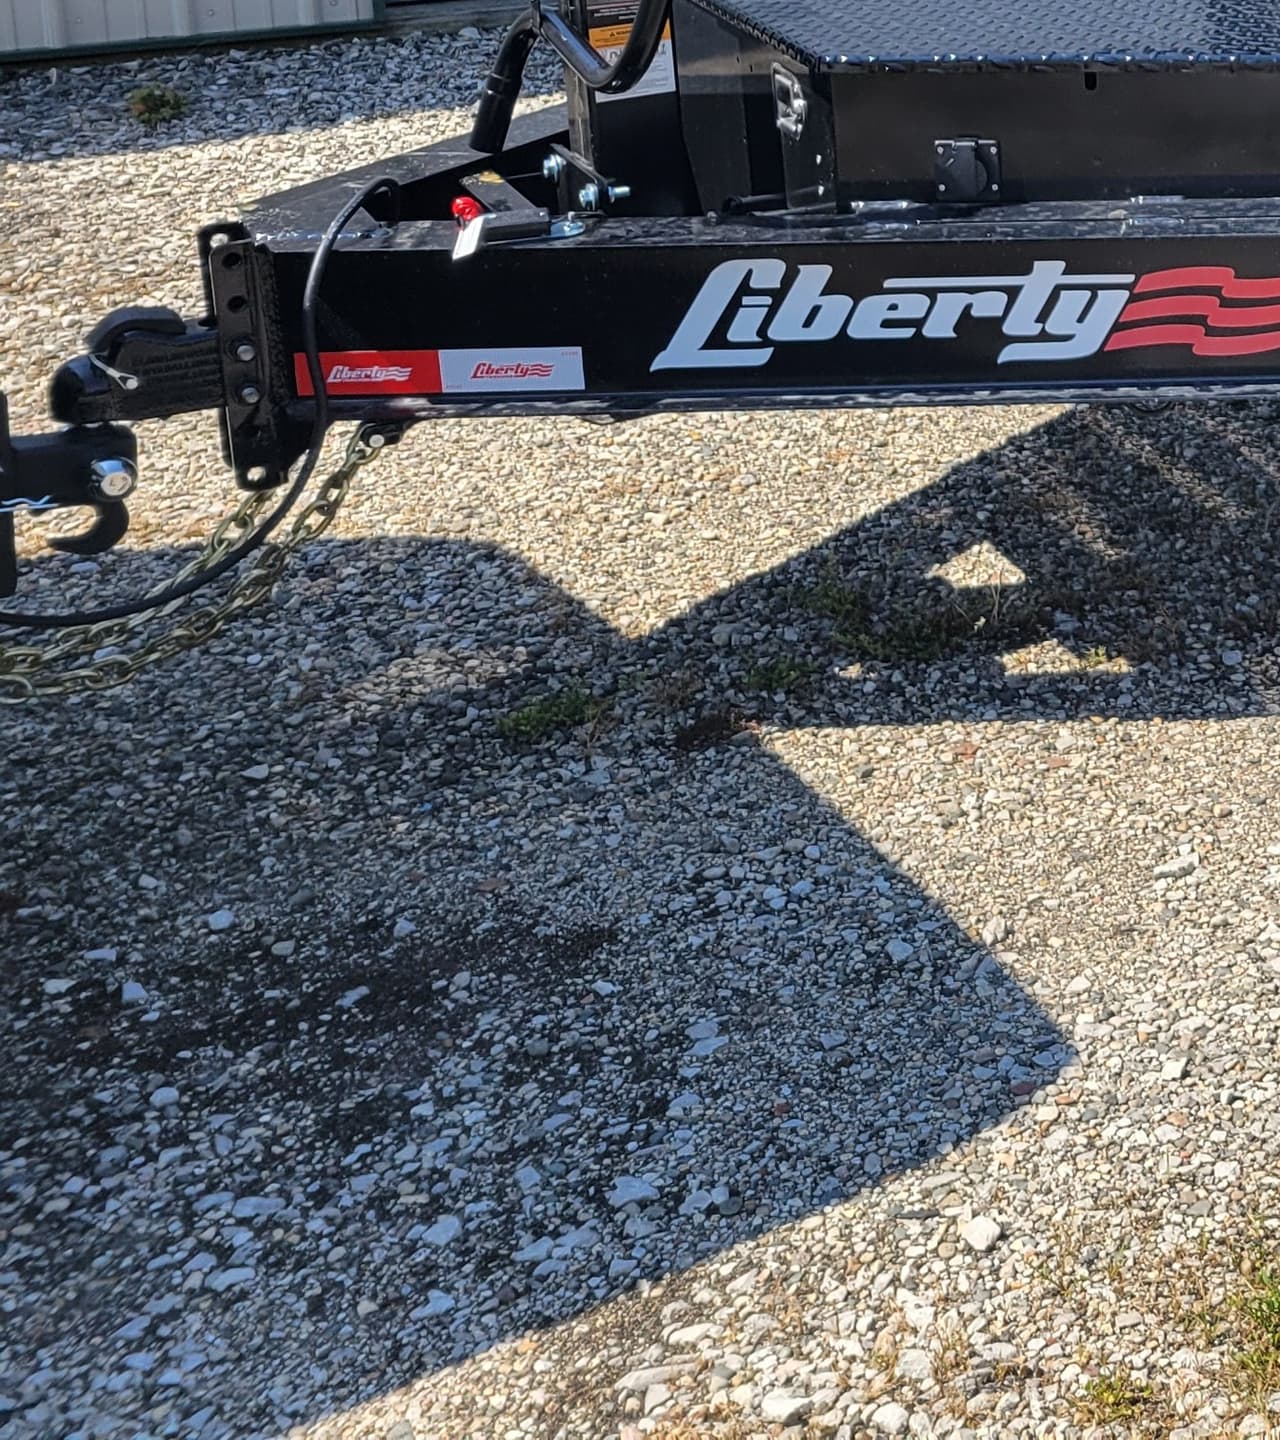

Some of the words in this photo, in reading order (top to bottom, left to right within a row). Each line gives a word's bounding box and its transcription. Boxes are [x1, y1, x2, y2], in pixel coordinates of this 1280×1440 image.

[650, 258, 1136, 373] Liberty
[327, 365, 388, 384] Liberty
[470, 362, 531, 380] Liberty
